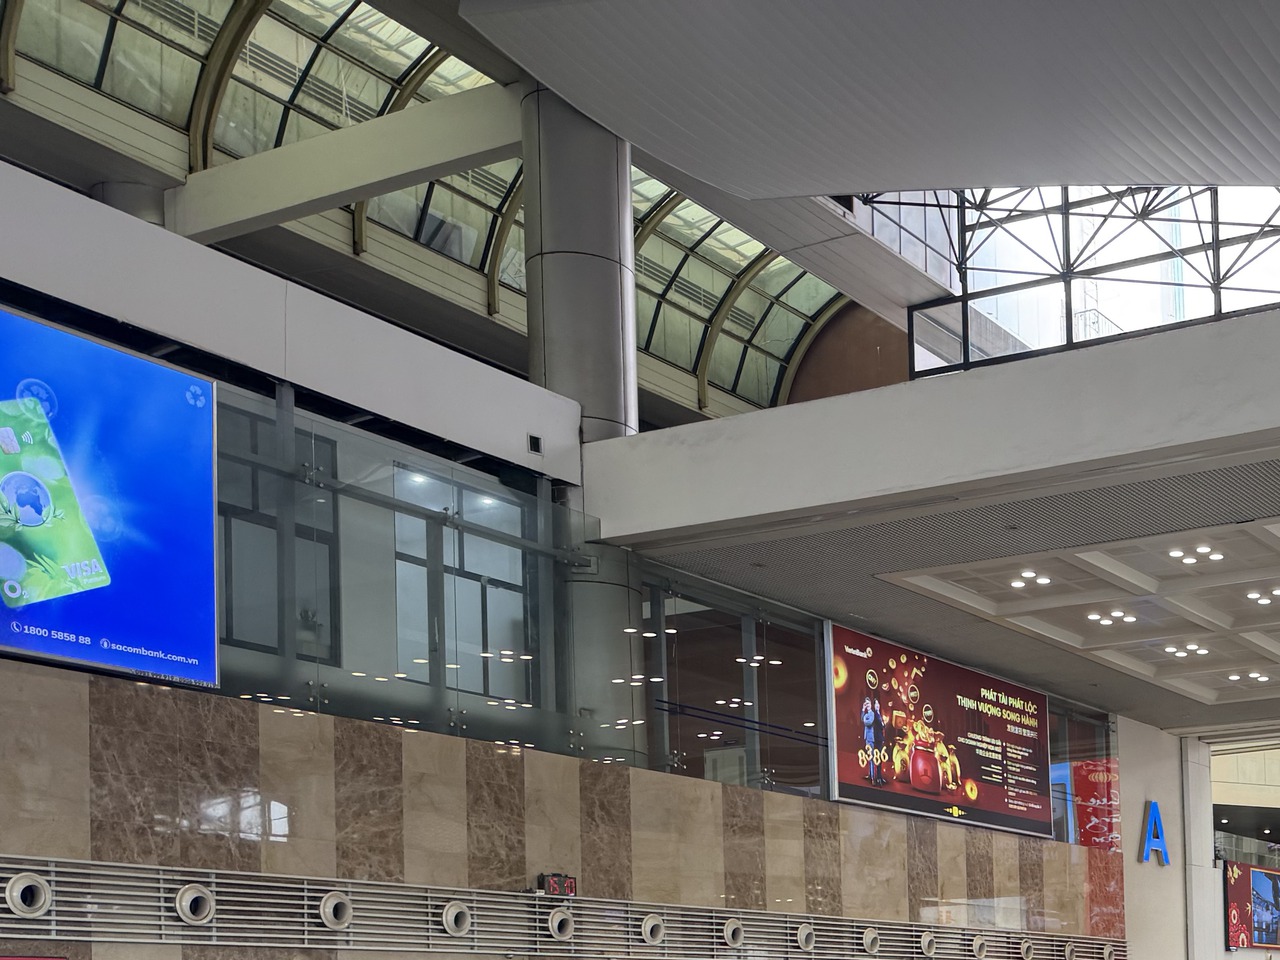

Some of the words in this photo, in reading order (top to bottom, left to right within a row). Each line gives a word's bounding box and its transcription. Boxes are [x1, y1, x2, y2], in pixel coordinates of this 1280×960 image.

[61, 558, 103, 580] VISA
[23, 624, 49, 637] 1800
[51, 630, 76, 643] 5858
[78, 635, 92, 645] 88
[111, 641, 199, 666] sacombank.com.vn
[956, 694, 977, 711] THỊNH
[978, 701, 1001, 717] VƯỢNG
[1002, 709, 1021, 723] SONG
[1021, 712, 1038, 728] HÀNH
[981, 688, 997, 702] PHÁT
[1009, 697, 1025, 710] PHÁT
[1025, 701, 1038, 715] LỘC
[858, 744, 888, 768] 8386
[1140, 800, 1170, 866] A
